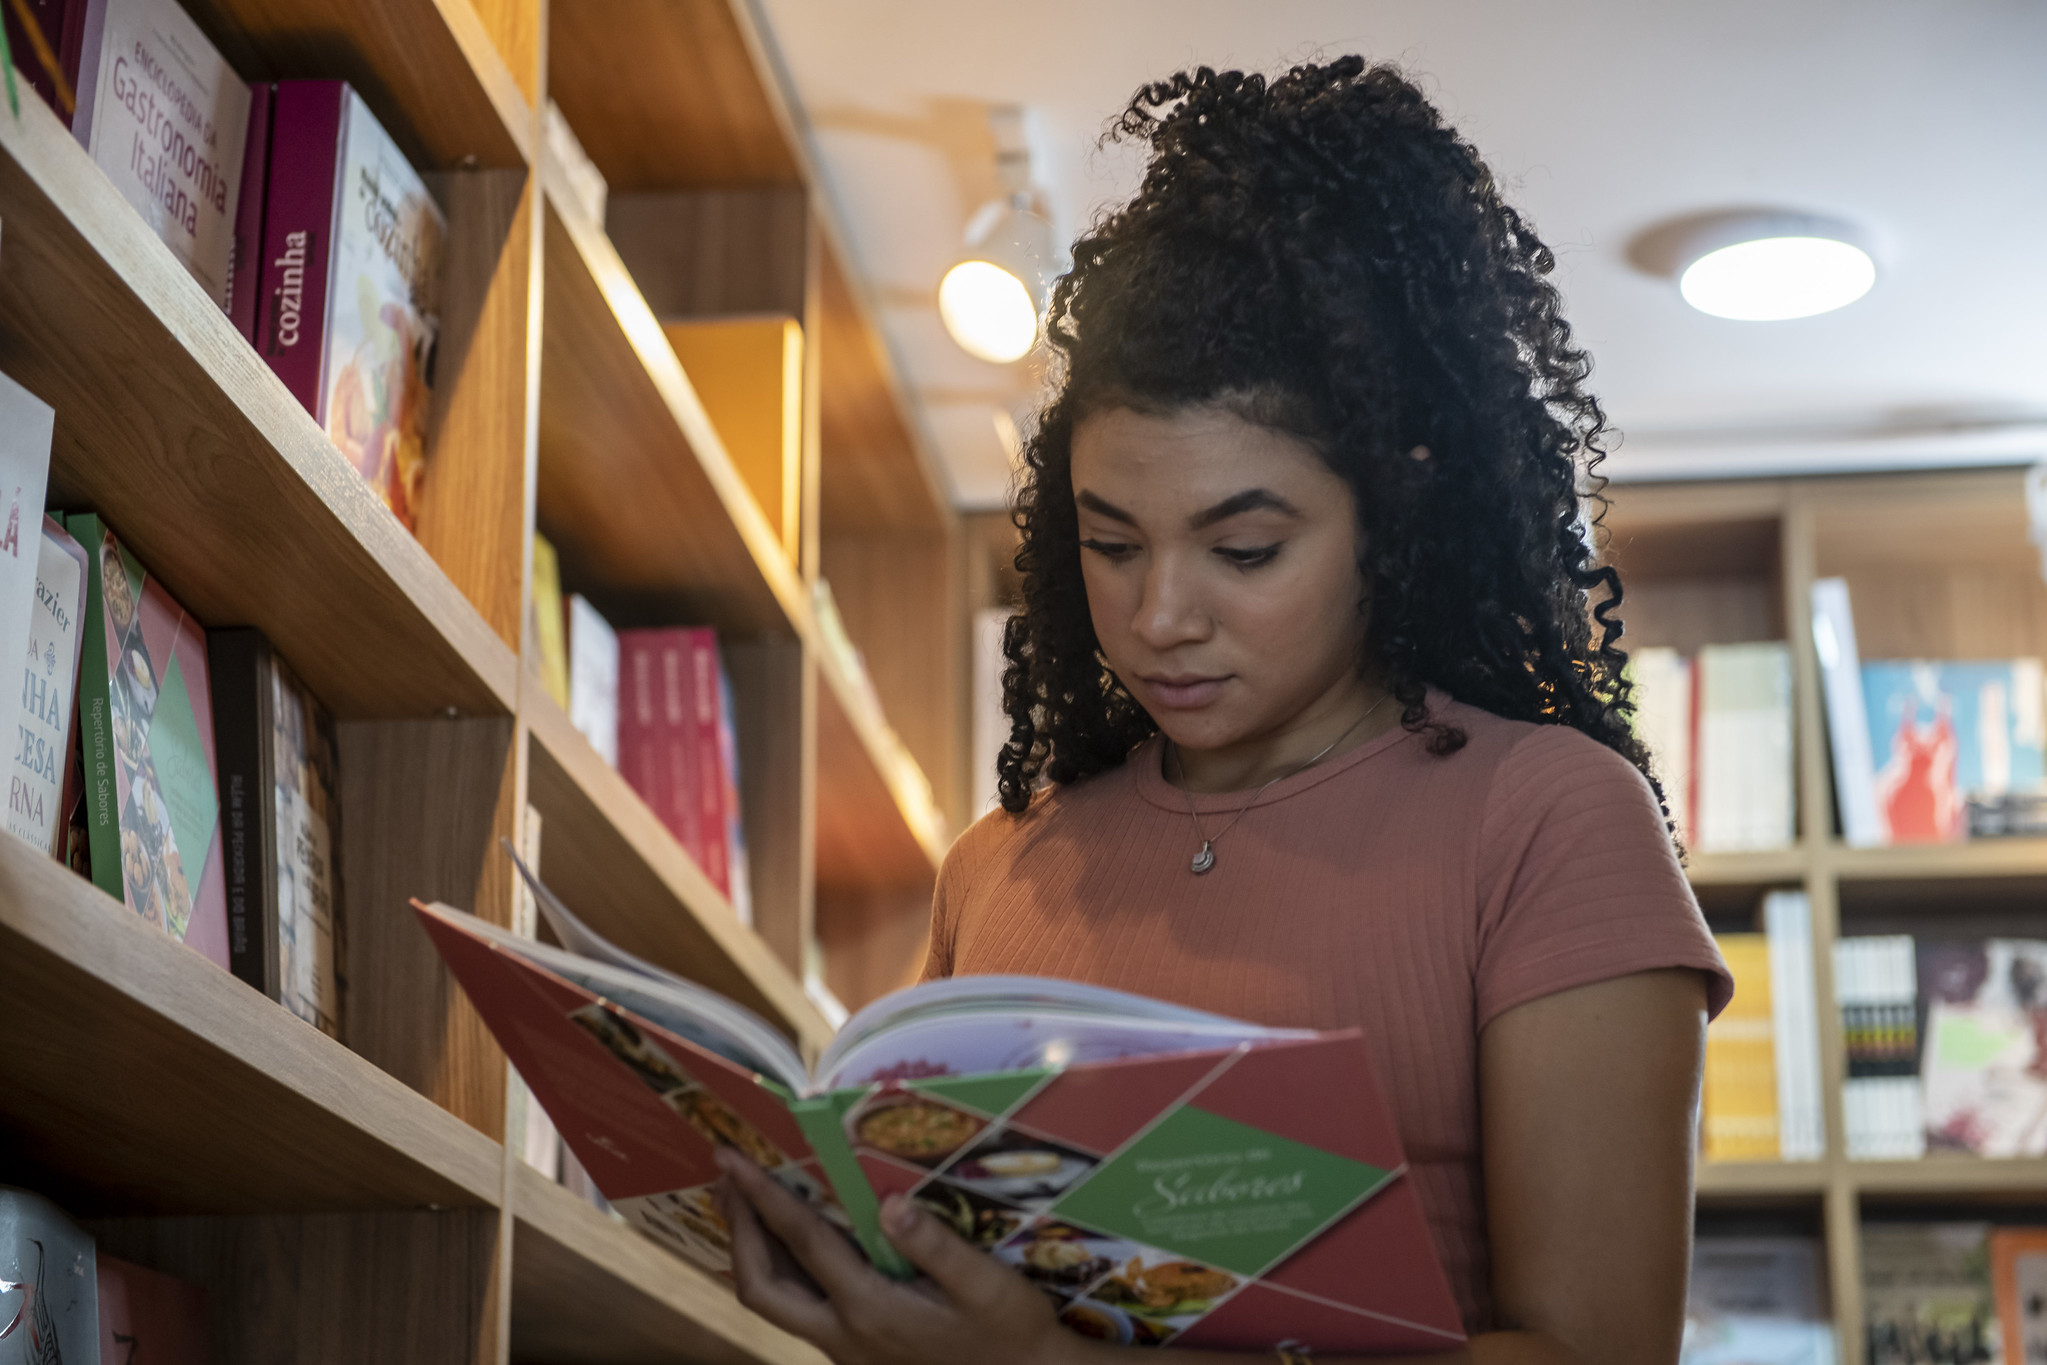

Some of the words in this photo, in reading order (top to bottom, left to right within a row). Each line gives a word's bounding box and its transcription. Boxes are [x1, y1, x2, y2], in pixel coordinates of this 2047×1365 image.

[113, 56, 227, 216] Gastronomia
[131, 130, 197, 238] Italiana
[274, 229, 307, 346] cozinha
[36, 576, 71, 633] azier
[14, 724, 56, 784] ESA
[92, 698, 105, 760] Repertório
[96, 760, 106, 776] de
[97, 778, 109, 826] Sabores
